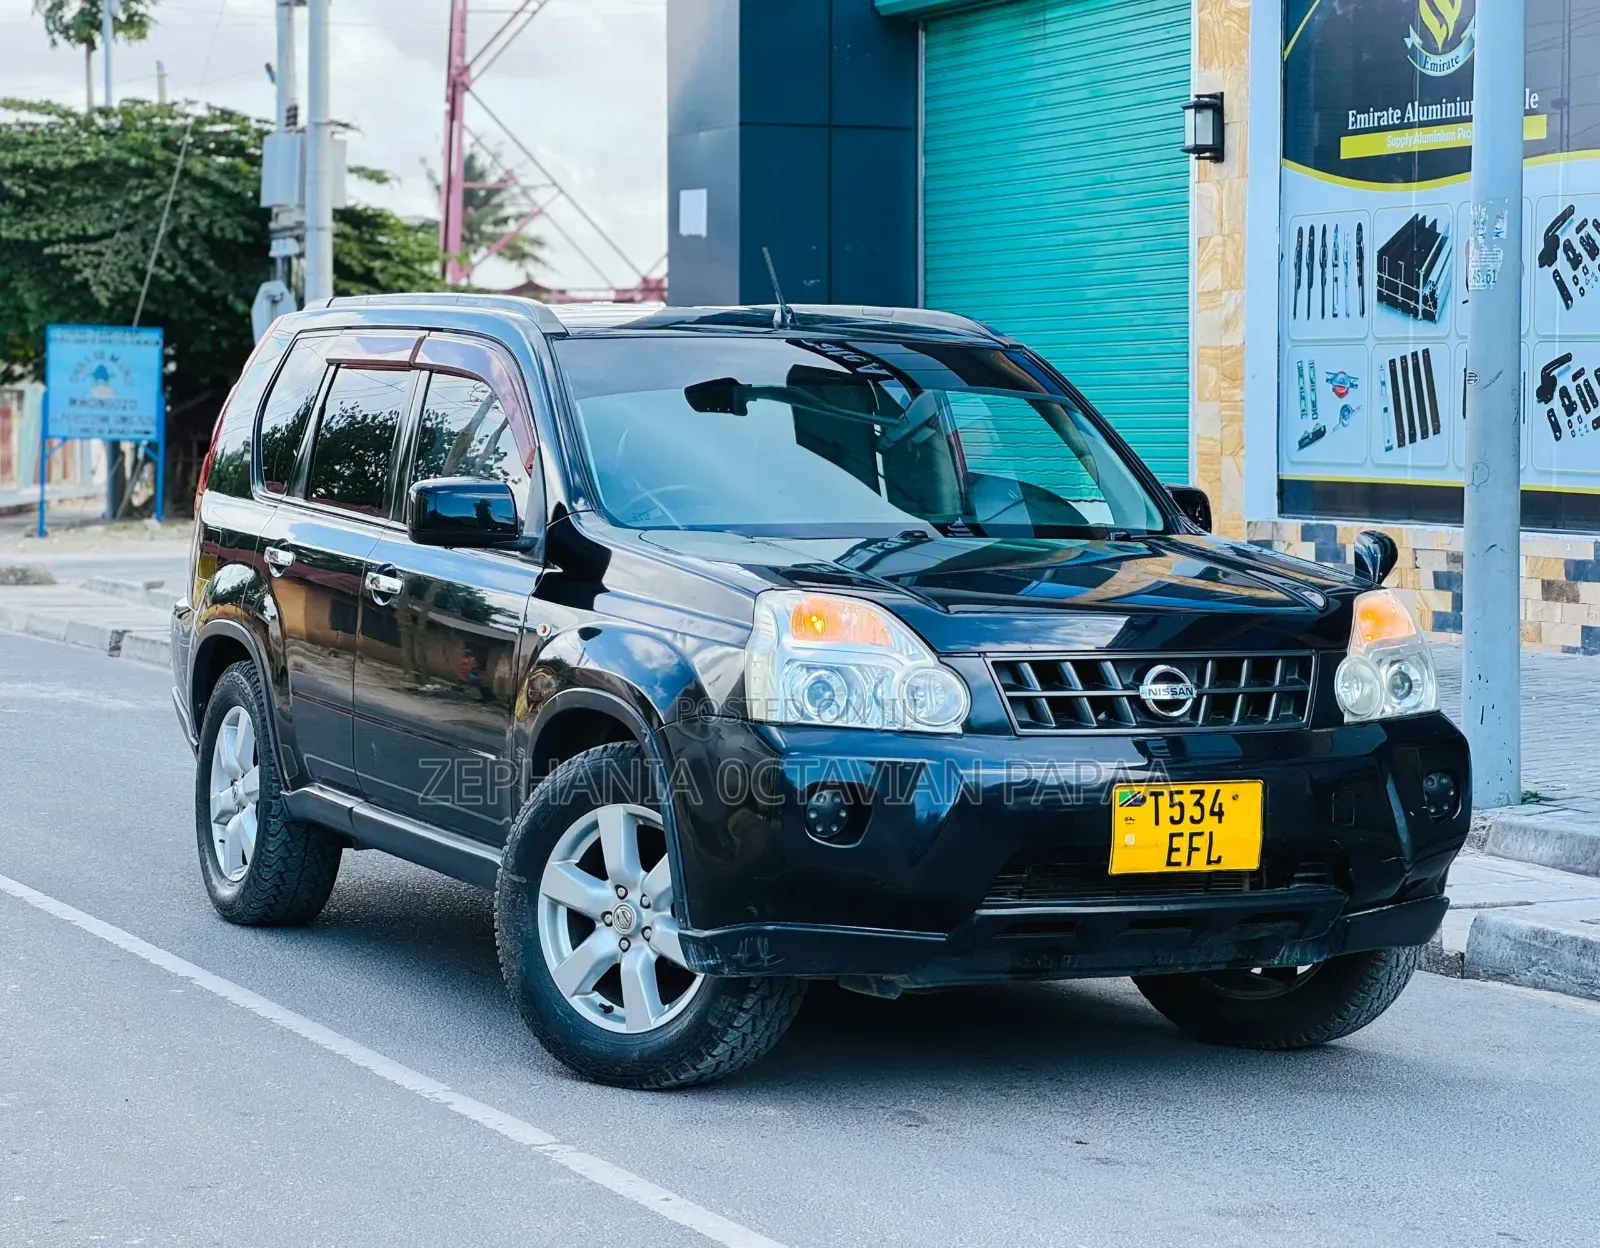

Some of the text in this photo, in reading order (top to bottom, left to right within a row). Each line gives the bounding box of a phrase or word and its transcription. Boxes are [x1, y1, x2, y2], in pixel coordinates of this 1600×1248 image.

[1423, 55, 1460, 73] Emirate
[1348, 106, 1401, 130] Emirate
[1386, 128, 1472, 149] Supply Aluminium Pro
[1148, 687, 1194, 697] NISSAN
[1149, 788, 1225, 826] T534
[1165, 831, 1222, 867] EFL
